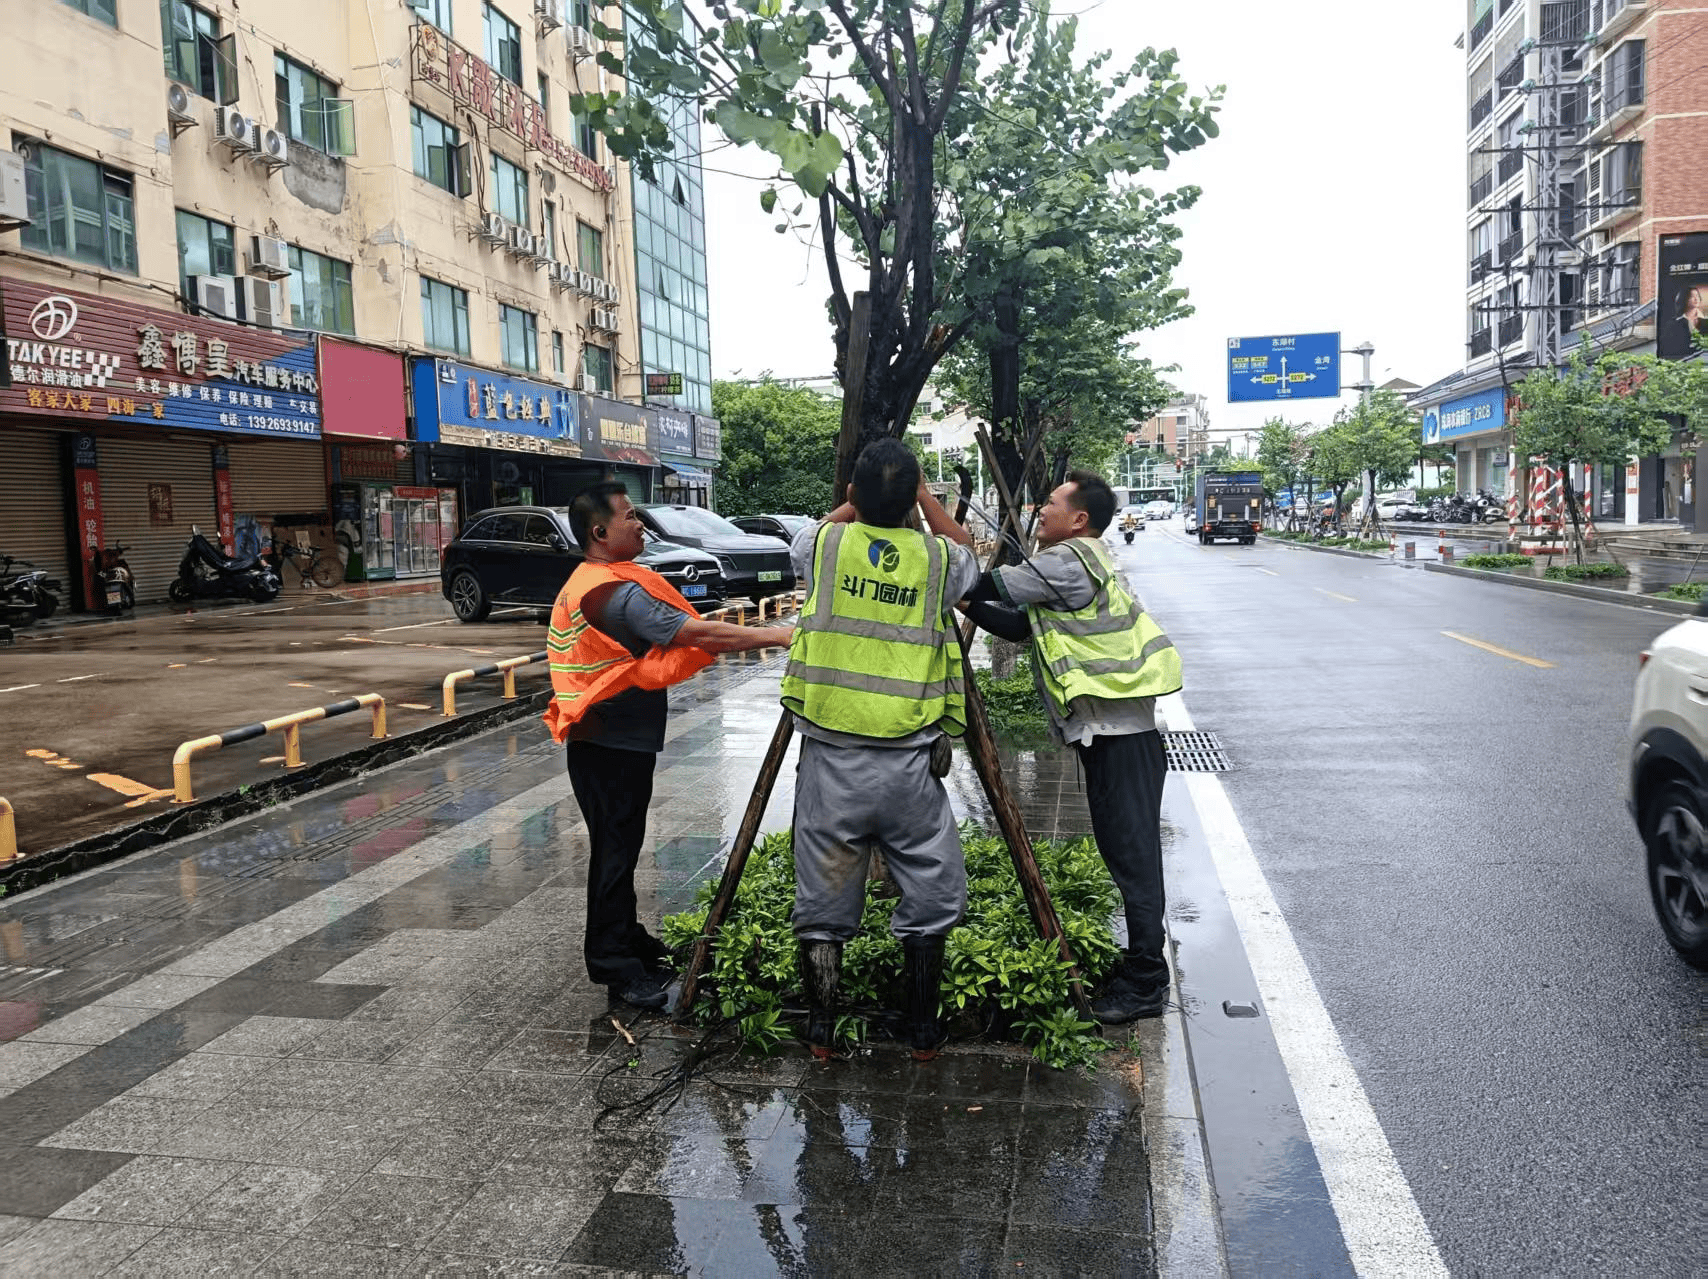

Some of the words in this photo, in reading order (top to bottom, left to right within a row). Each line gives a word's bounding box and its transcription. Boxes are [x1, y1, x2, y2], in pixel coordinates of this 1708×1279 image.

[7, 340, 82, 369] TAKYEE
[137, 322, 231, 379] 鑫博皇
[233, 359, 318, 394] 汽车服务中心
[10, 364, 82, 389] 德尔润滑油
[135, 377, 161, 395] 美容
[168, 381, 193, 399] 维修
[199, 386, 222, 403] 保养
[82, 481, 95, 510] 机油
[85, 519, 98, 549] 轮胎
[841, 574, 918, 607] 斗门园林
